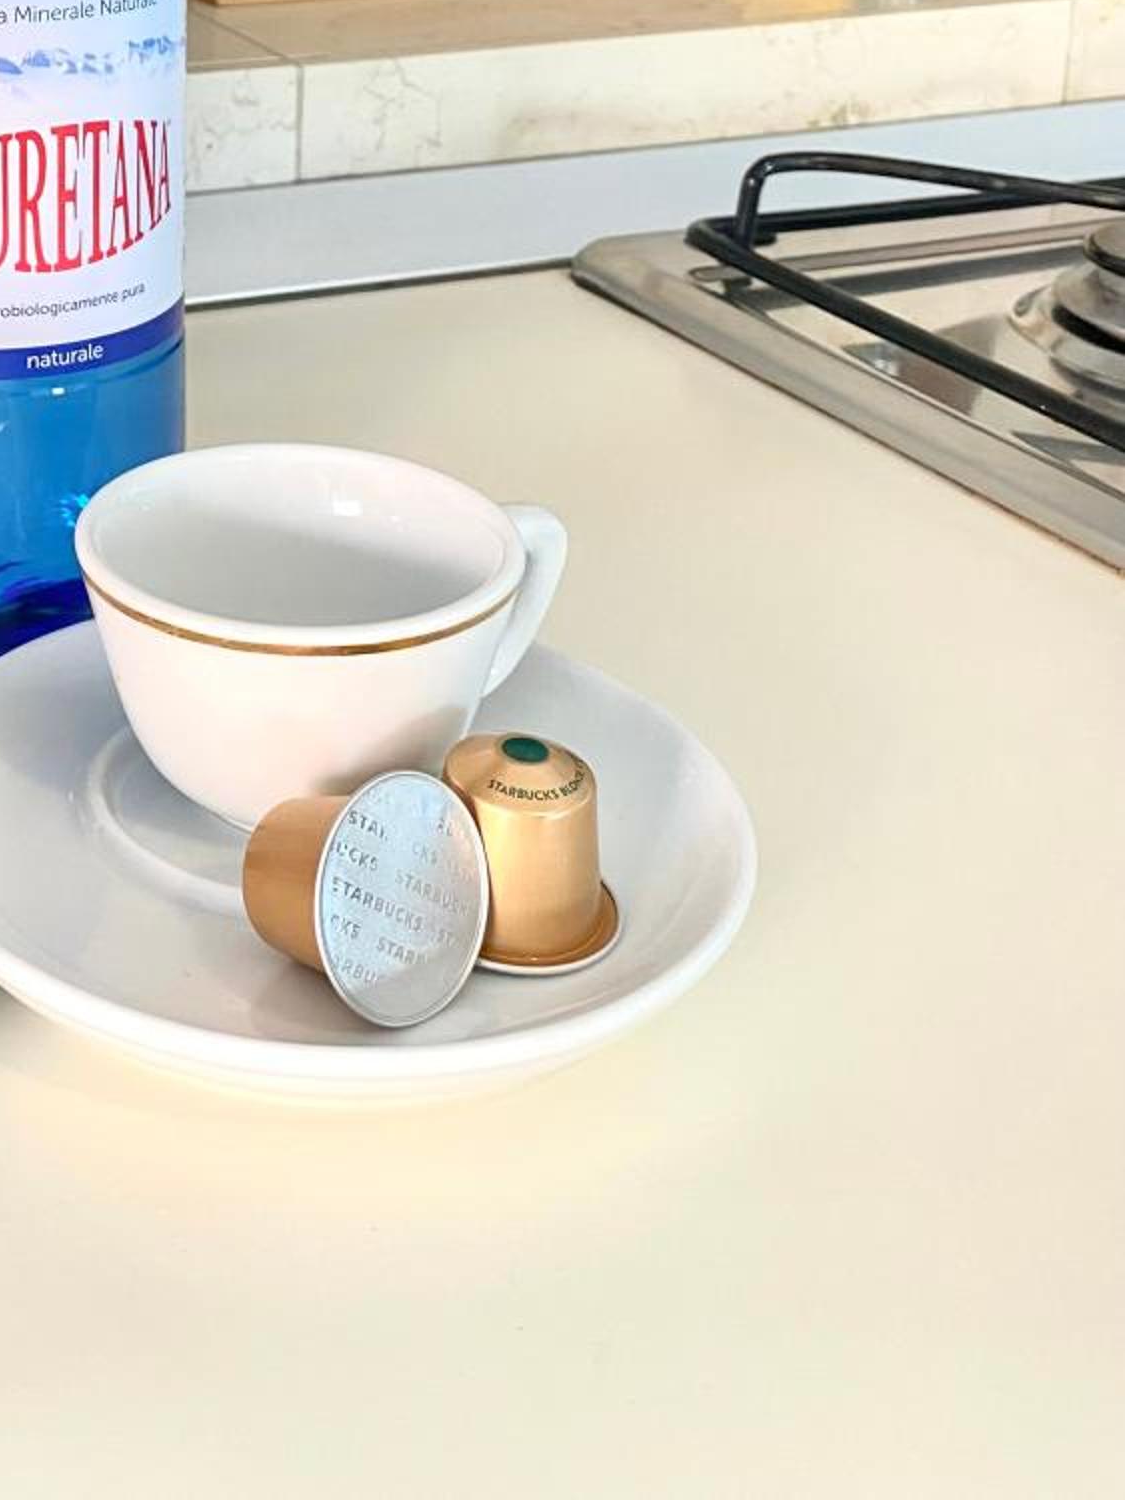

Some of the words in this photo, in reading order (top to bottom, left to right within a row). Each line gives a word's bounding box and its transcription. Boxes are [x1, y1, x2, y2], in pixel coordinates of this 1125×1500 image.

[14, 0, 95, 23] Minerale
[121, 282, 146, 303] pura
[27, 343, 104, 369] naturale
[487, 779, 560, 801] STARBUCKS
[332, 876, 426, 933] STARBUCKS
